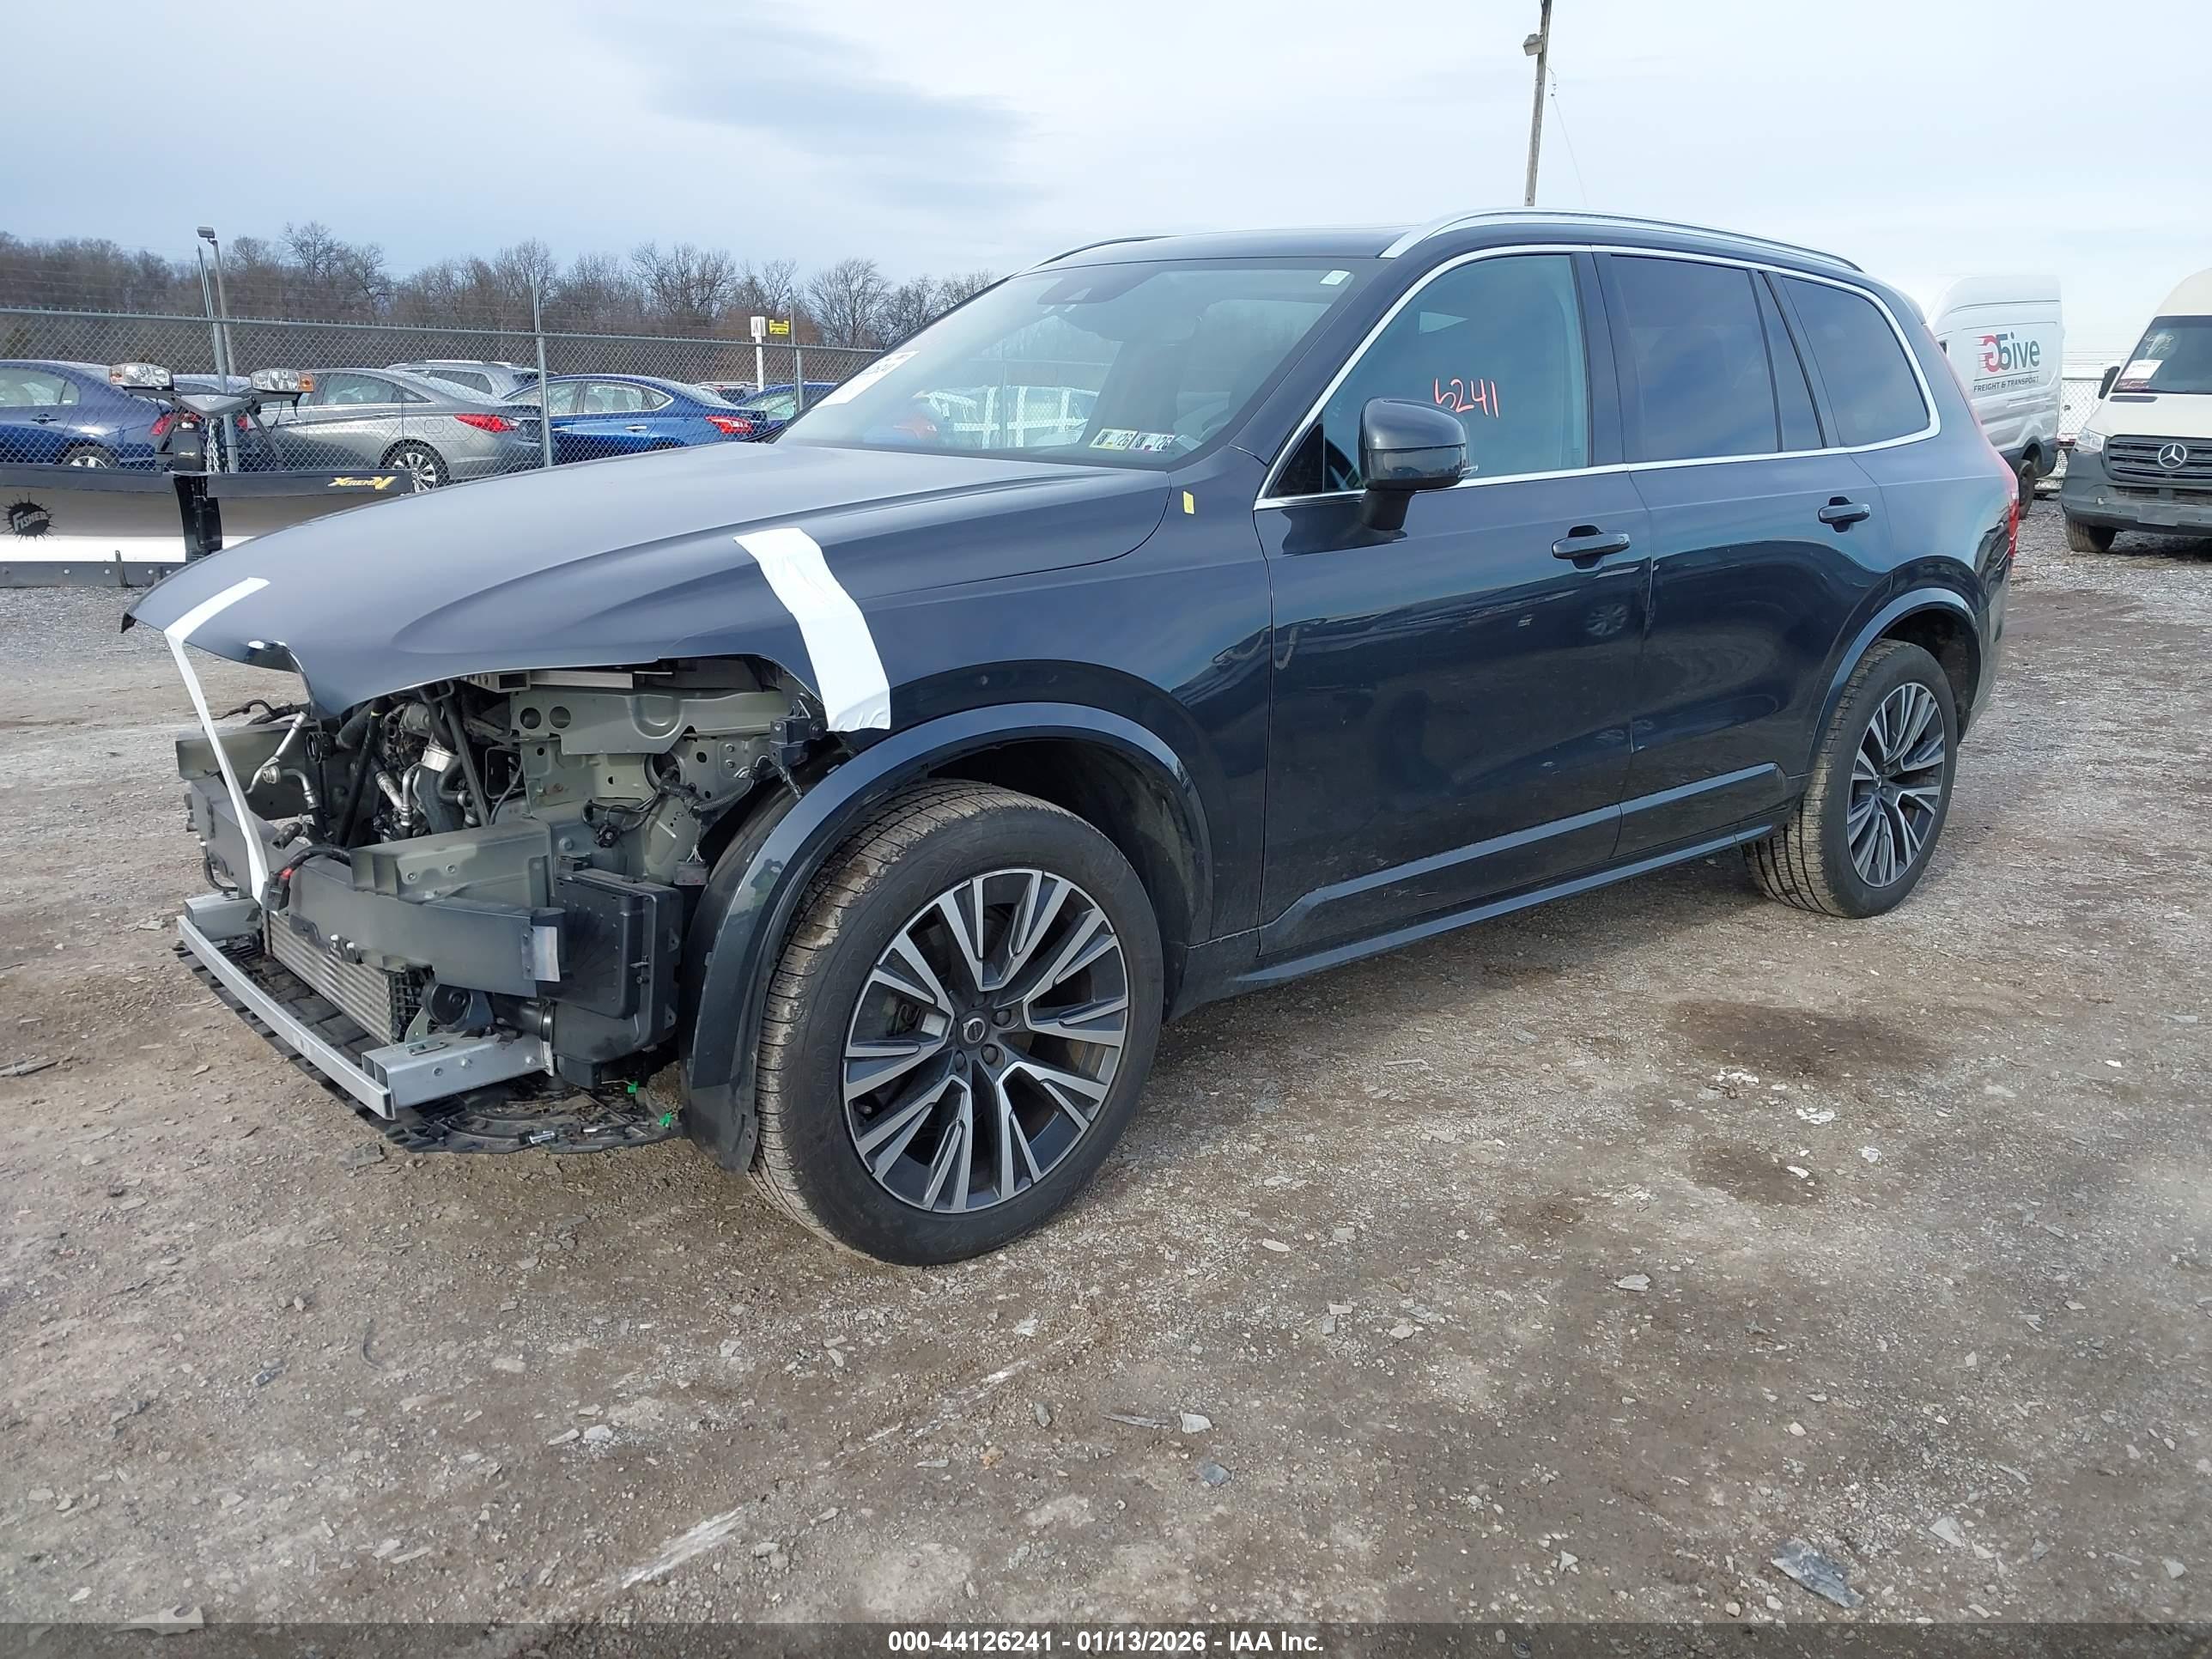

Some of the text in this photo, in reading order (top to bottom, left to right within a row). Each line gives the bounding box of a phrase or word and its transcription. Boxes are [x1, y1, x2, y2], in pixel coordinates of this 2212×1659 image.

[1973, 376, 2039, 392] FREIGHT & TRANSPORT
